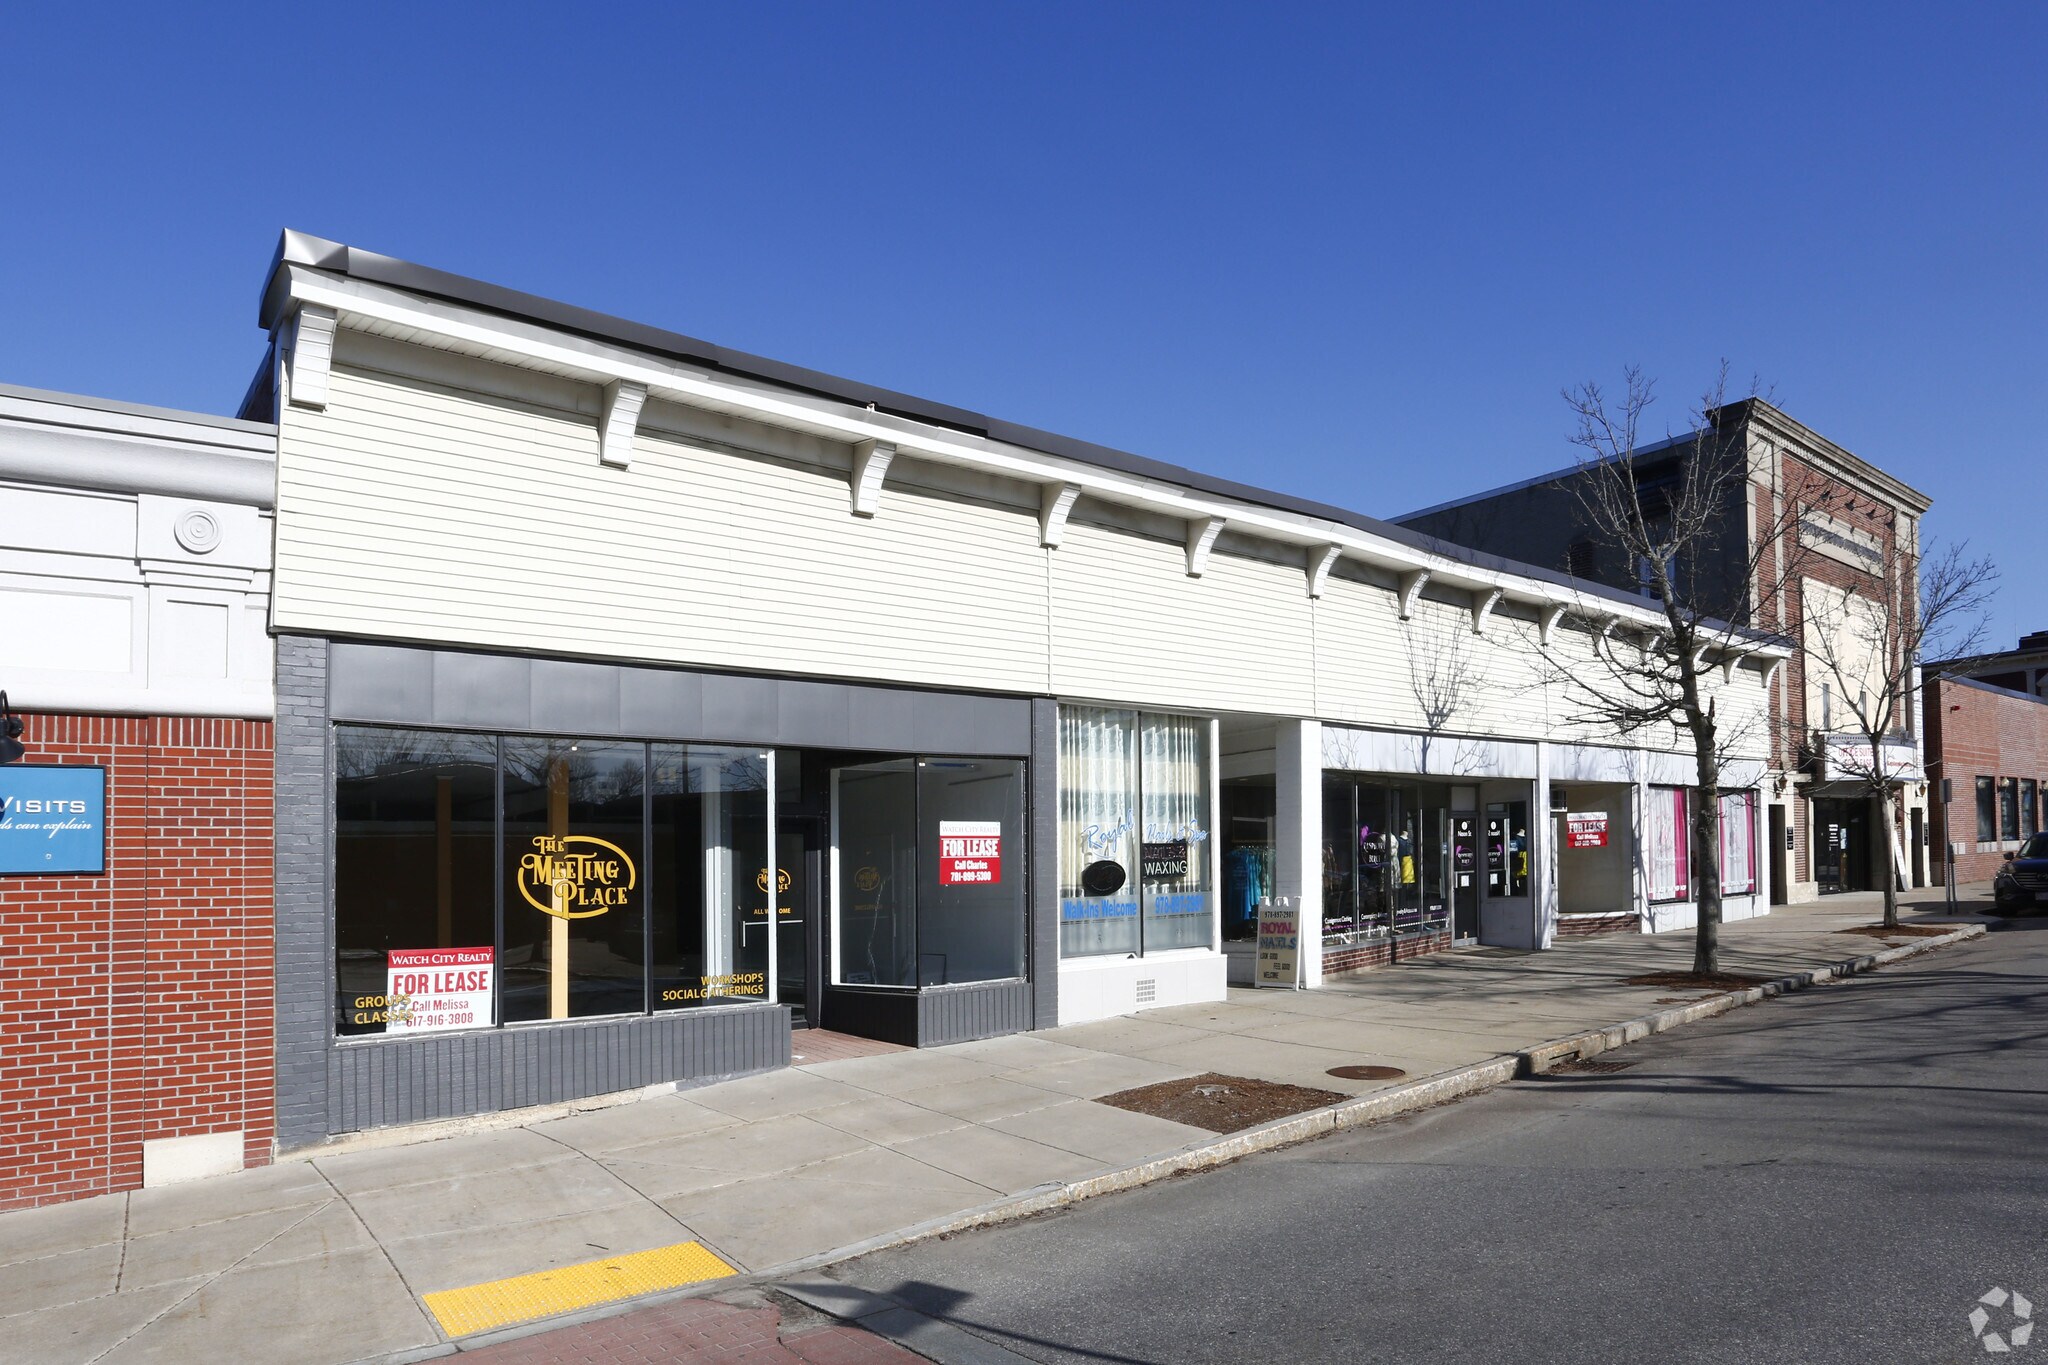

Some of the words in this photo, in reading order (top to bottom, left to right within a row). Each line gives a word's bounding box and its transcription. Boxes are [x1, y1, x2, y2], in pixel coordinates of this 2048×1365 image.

[43, 817, 93, 839] explain
[1081, 808, 1134, 852] Royal
[1569, 822, 1583, 832] FOR
[1584, 822, 1606, 832] LEASE
[943, 840, 965, 856] FOR
[967, 840, 998, 856] LEASE
[955, 860, 966, 870] Call
[1144, 860, 1187, 875] WAXING
[1064, 900, 1098, 919] Walk-Ins
[1102, 900, 1136, 917] Welcome
[1261, 922, 1296, 934] ROYAL
[393, 974, 429, 995] FOR
[434, 971, 488, 992] LEASE
[701, 973, 764, 986] WORKSHOPS
[355, 994, 411, 1008] GROUPS
[412, 1000, 430, 1012] Call
[433, 999, 468, 1011] Melissa
[354, 1009, 414, 1024] CLASSES
[406, 1013, 473, 1027] 617-916-3808
